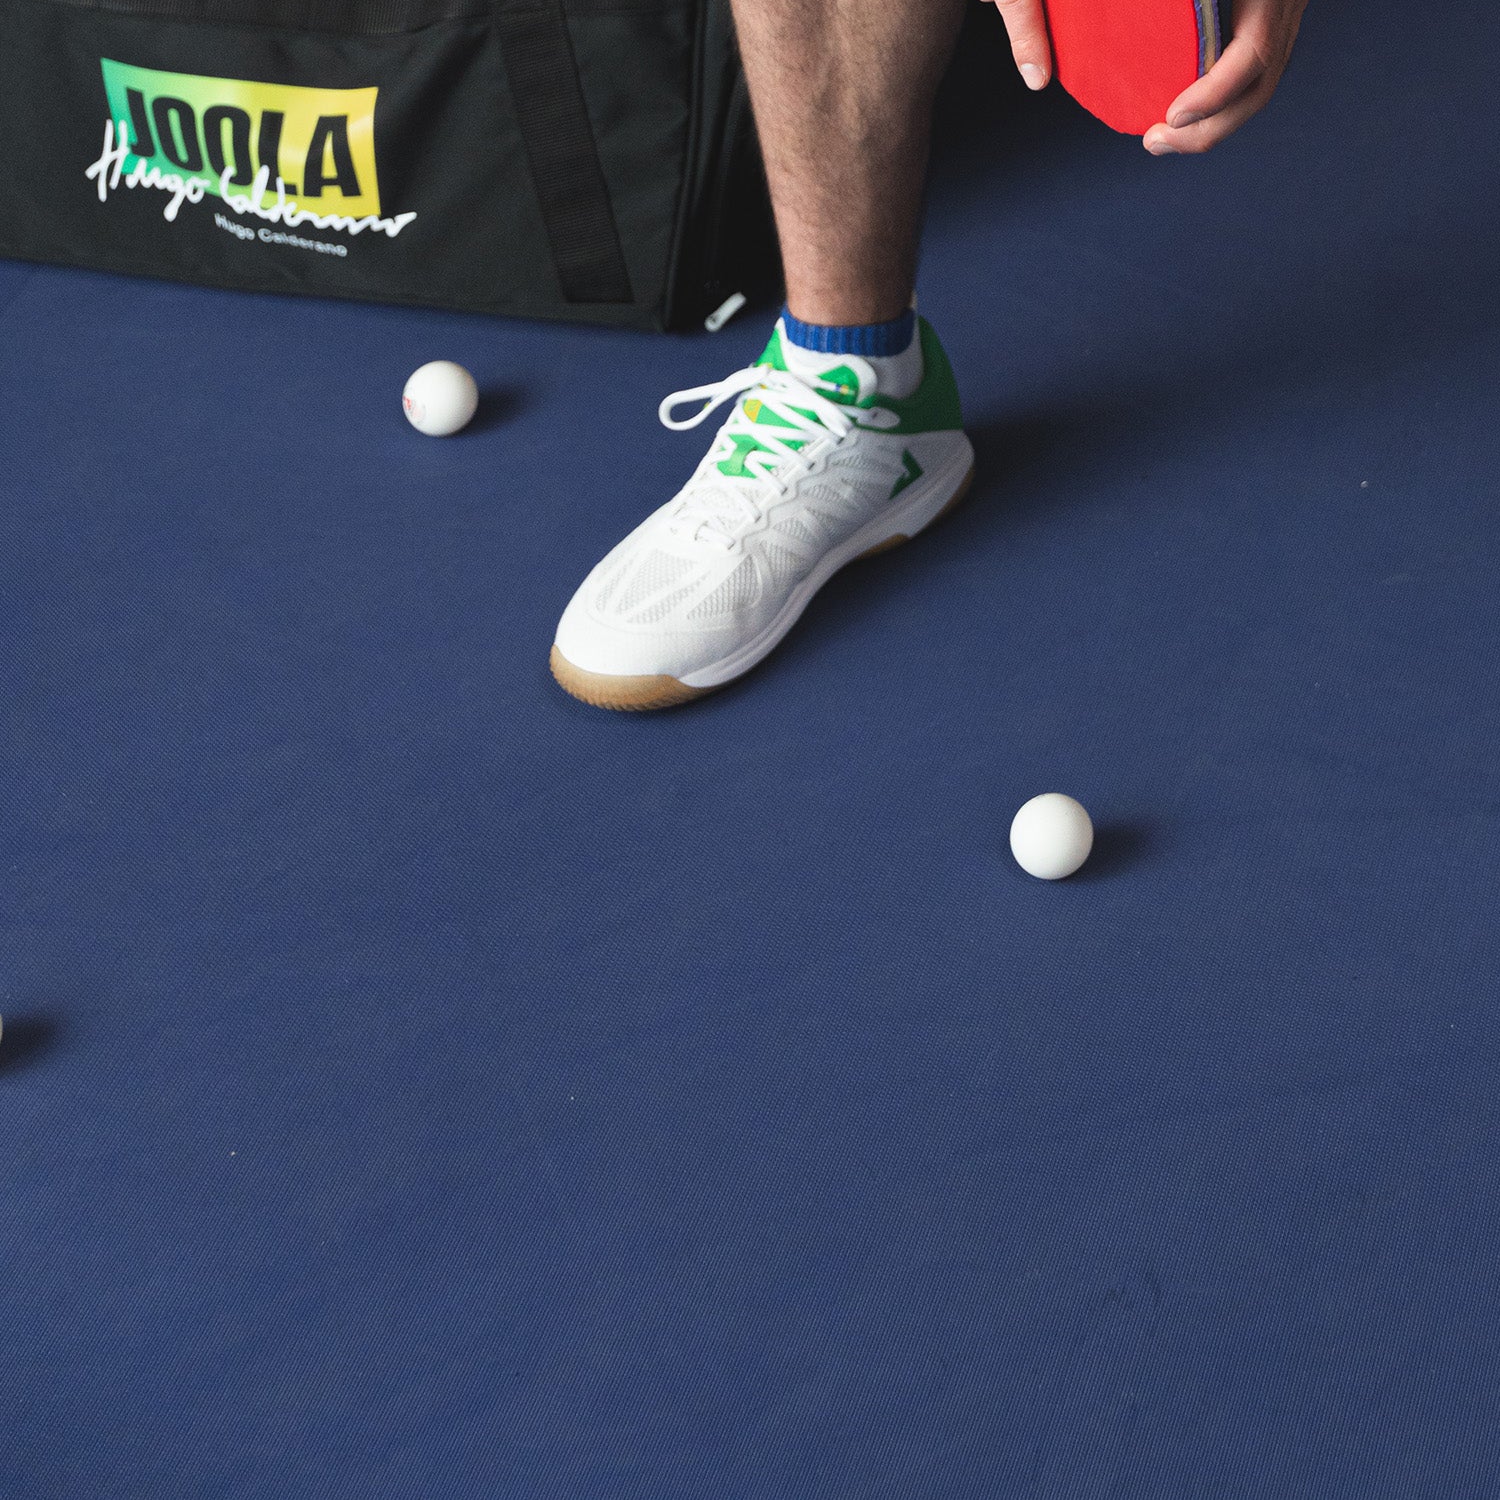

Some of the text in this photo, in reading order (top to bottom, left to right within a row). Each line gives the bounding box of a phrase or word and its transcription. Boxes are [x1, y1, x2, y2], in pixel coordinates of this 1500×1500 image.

[84, 118, 211, 222] Hugo
[125, 86, 362, 198] JOOLA
[214, 213, 348, 257] Hugo Calderano
